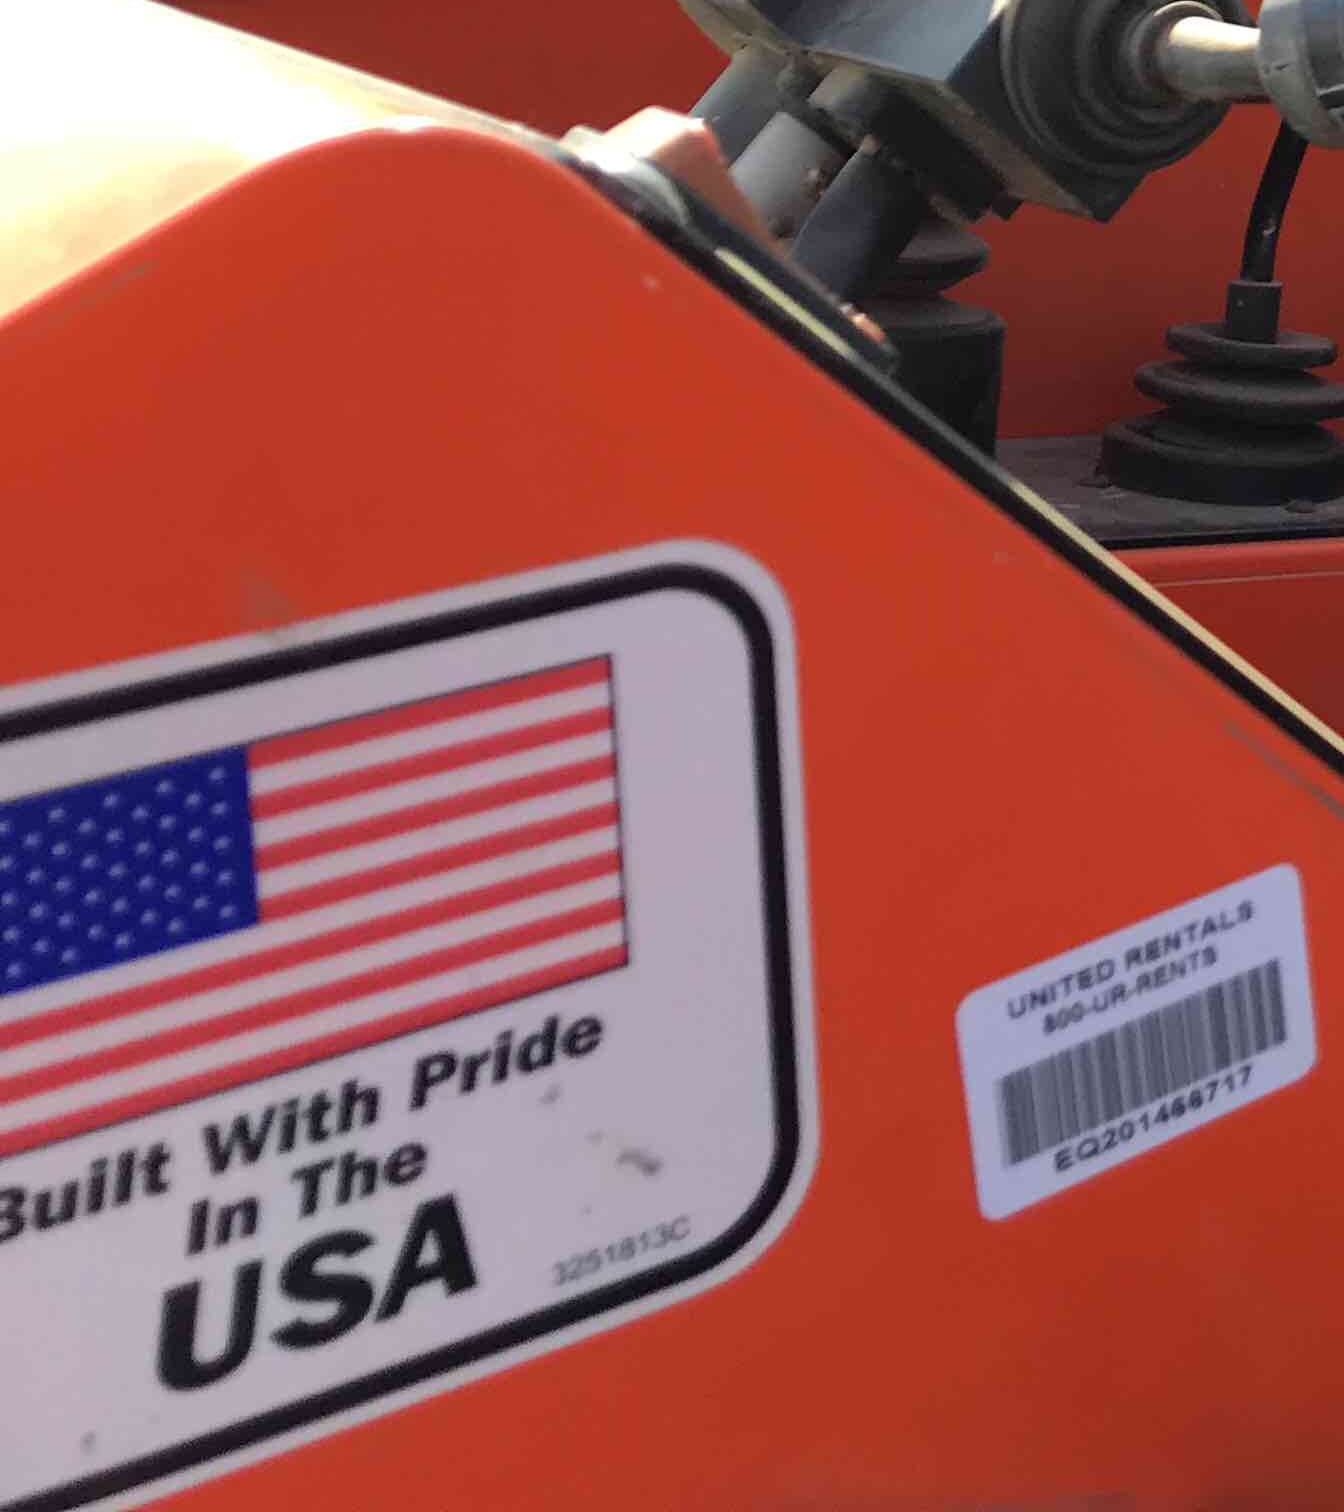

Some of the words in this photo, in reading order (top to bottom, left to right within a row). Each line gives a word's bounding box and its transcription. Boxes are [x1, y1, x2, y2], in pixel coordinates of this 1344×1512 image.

[1007, 958, 1116, 1020] UNITED
[1123, 899, 1254, 971] RENTALS
[202, 1076, 382, 1177] With
[409, 1012, 604, 1112] Pride
[185, 1194, 260, 1258] In
[290, 1141, 429, 1220] The
[156, 1192, 480, 1393] USA
